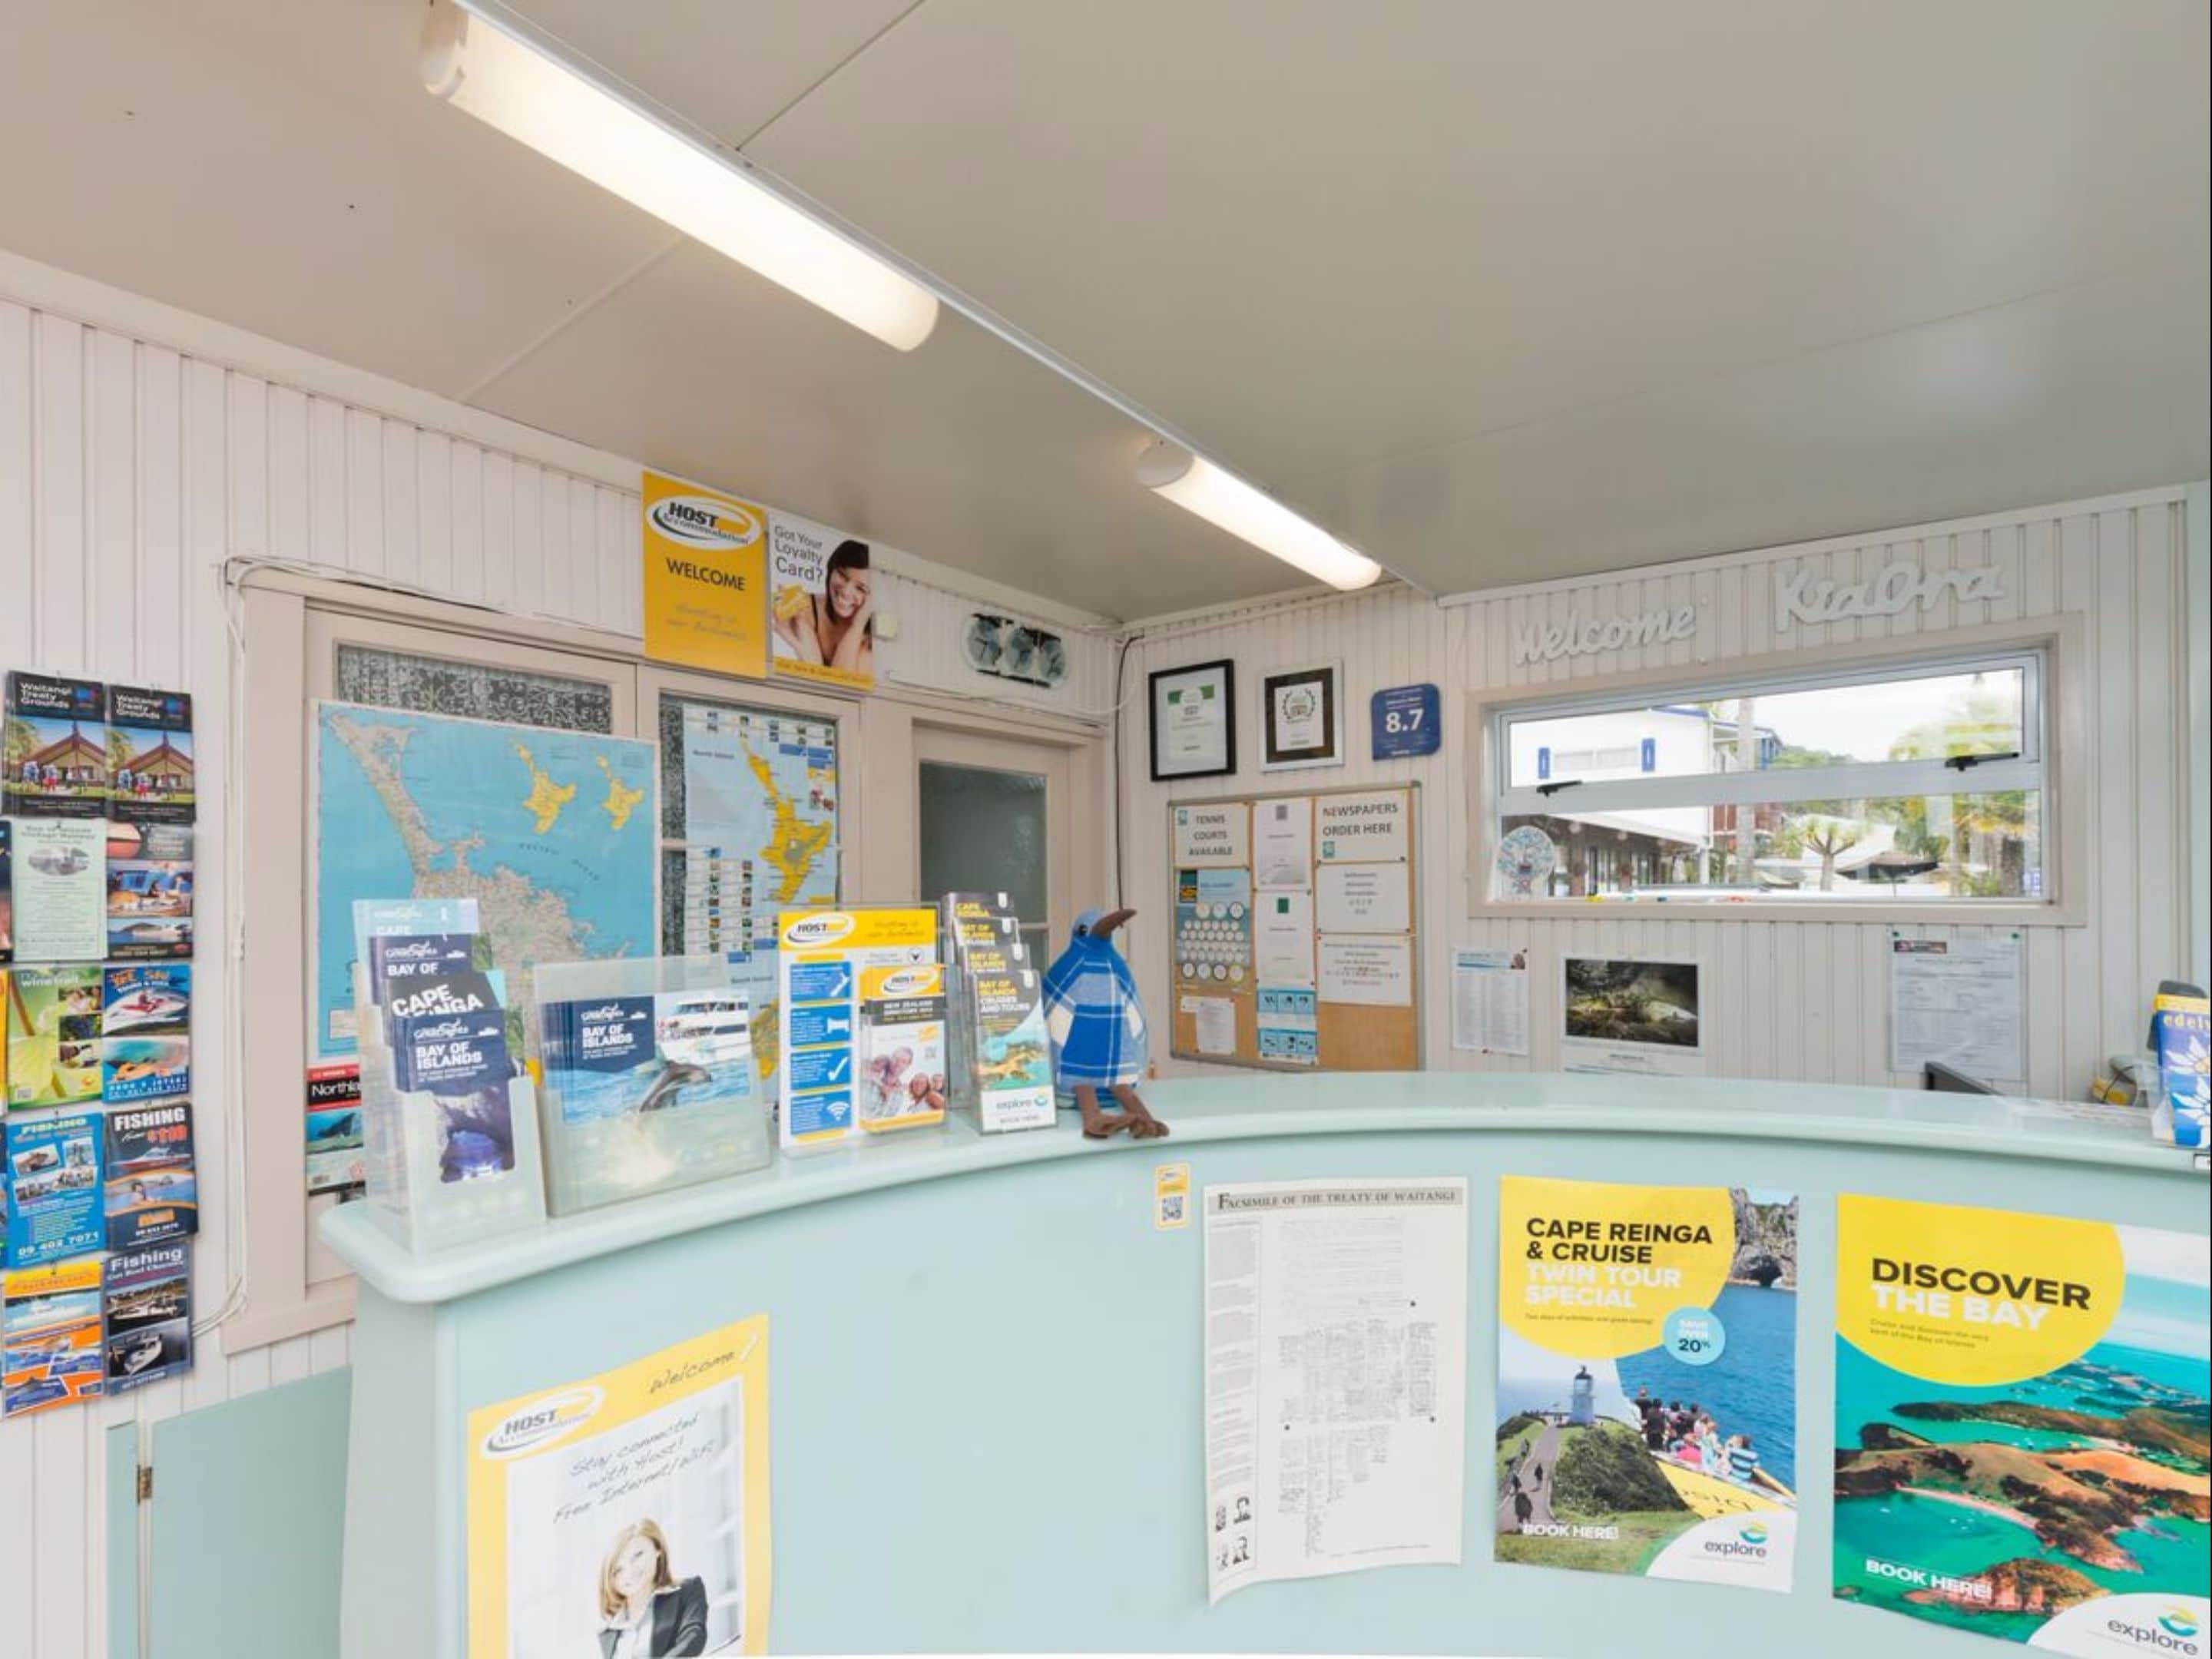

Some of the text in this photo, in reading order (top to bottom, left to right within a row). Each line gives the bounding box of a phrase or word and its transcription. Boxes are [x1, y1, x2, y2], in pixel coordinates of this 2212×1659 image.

[668, 502, 719, 527] HOST
[774, 525, 823, 549] Got Your
[775, 539, 823, 566] Loyalty
[666, 557, 746, 591] WELCOME
[776, 558, 823, 584] Card?
[1511, 604, 1697, 667] Welcome
[1386, 708, 1424, 733] 8.7
[1196, 815, 1226, 824] TENNIS
[1323, 803, 1398, 817] NEWSPAPERS
[1193, 831, 1227, 840] COURTS
[1322, 823, 1392, 836] ORDER HERE
[1189, 847, 1233, 856] AVAILABLE
[955, 902, 980, 911] CAPE
[797, 923, 827, 933] HOST
[387, 962, 439, 976] BAY OF
[979, 980, 995, 988] BAY
[979, 988, 1017, 996] ISLANDS
[392, 984, 454, 1017] CAPE
[981, 1002, 1031, 1013] AND TOURS
[582, 1024, 624, 1038] BAY OF
[582, 1033, 634, 1048] ISLANDS
[416, 1041, 469, 1058] BAY OF
[417, 1051, 482, 1069] ISLANDS
[997, 1099, 1031, 1109] explore
[114, 1107, 186, 1131] FISHING
[1282, 1196, 1296, 1206] OF
[1303, 1195, 1322, 1204] THE
[1327, 1192, 1371, 1204] TREATY
[1375, 1194, 1388, 1204] OF
[1393, 1191, 1455, 1203] WAITANGI
[1526, 1217, 1713, 1244] CAPE REINGA
[110, 1247, 183, 1272] Fishing
[1526, 1241, 1653, 1264] & CRUISE
[1526, 1263, 1682, 1289] TWIN TOUR
[1873, 1257, 2091, 1310] DISCOVER
[1526, 1284, 1637, 1308] SPECIAL
[1871, 1284, 2050, 1331] THE BAY
[1677, 1338, 1711, 1353] 20%
[649, 1351, 735, 1394] Welcome
[505, 1408, 558, 1435] HOST
[570, 1411, 699, 1477] Stay connected
[588, 1433, 684, 1489] with Host!
[553, 1501, 591, 1524] Free
[1522, 1524, 1619, 1540] BOOK HERE!
[1704, 1541, 1768, 1558] explore
[1866, 1559, 1992, 1600] BOOK HERE!
[2107, 1618, 2199, 1657] explore
